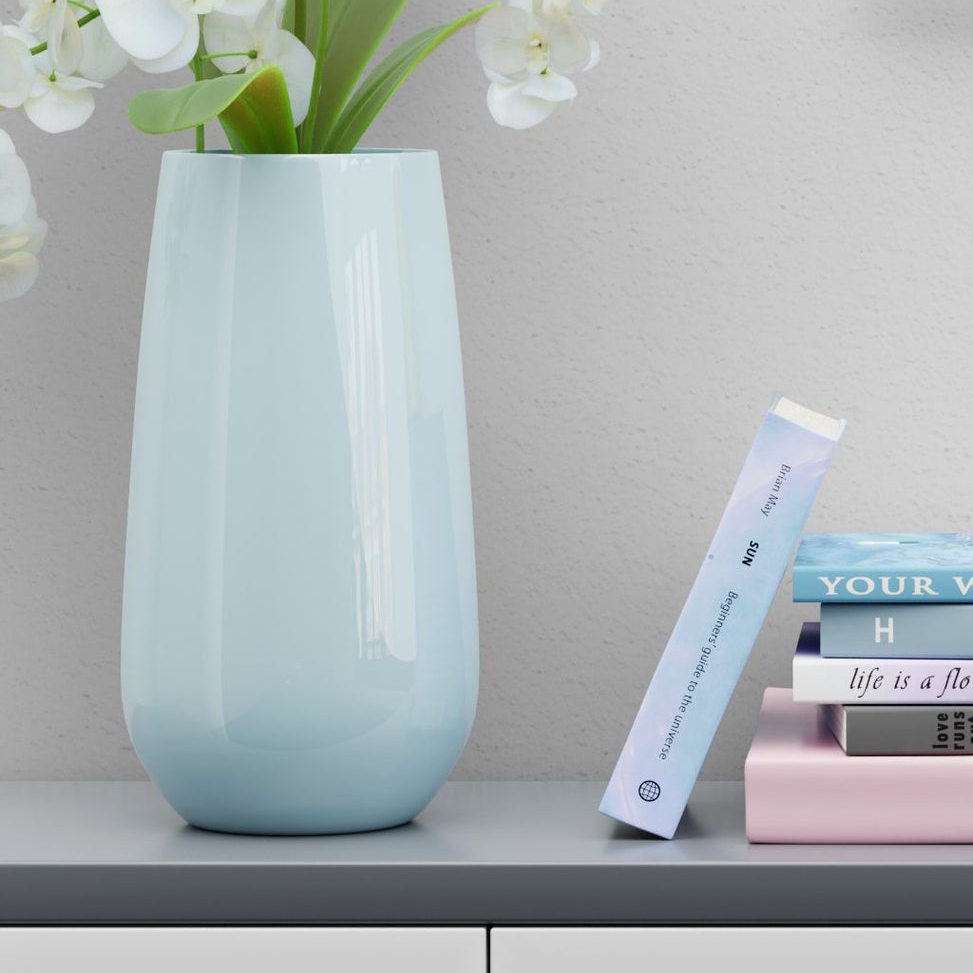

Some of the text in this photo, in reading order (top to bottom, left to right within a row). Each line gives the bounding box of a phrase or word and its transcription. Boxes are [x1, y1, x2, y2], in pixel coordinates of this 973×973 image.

[760, 463, 791, 517] Brian May
[741, 540, 759, 567] SUN
[818, 576, 939, 596] YOUR
[659, 590, 738, 761] Beginners' guide to the universe
[849, 667, 884, 699] life
[894, 670, 911, 690] is
[920, 675, 935, 690] a
[932, 712, 949, 749] love
[953, 711, 965, 750] runs
